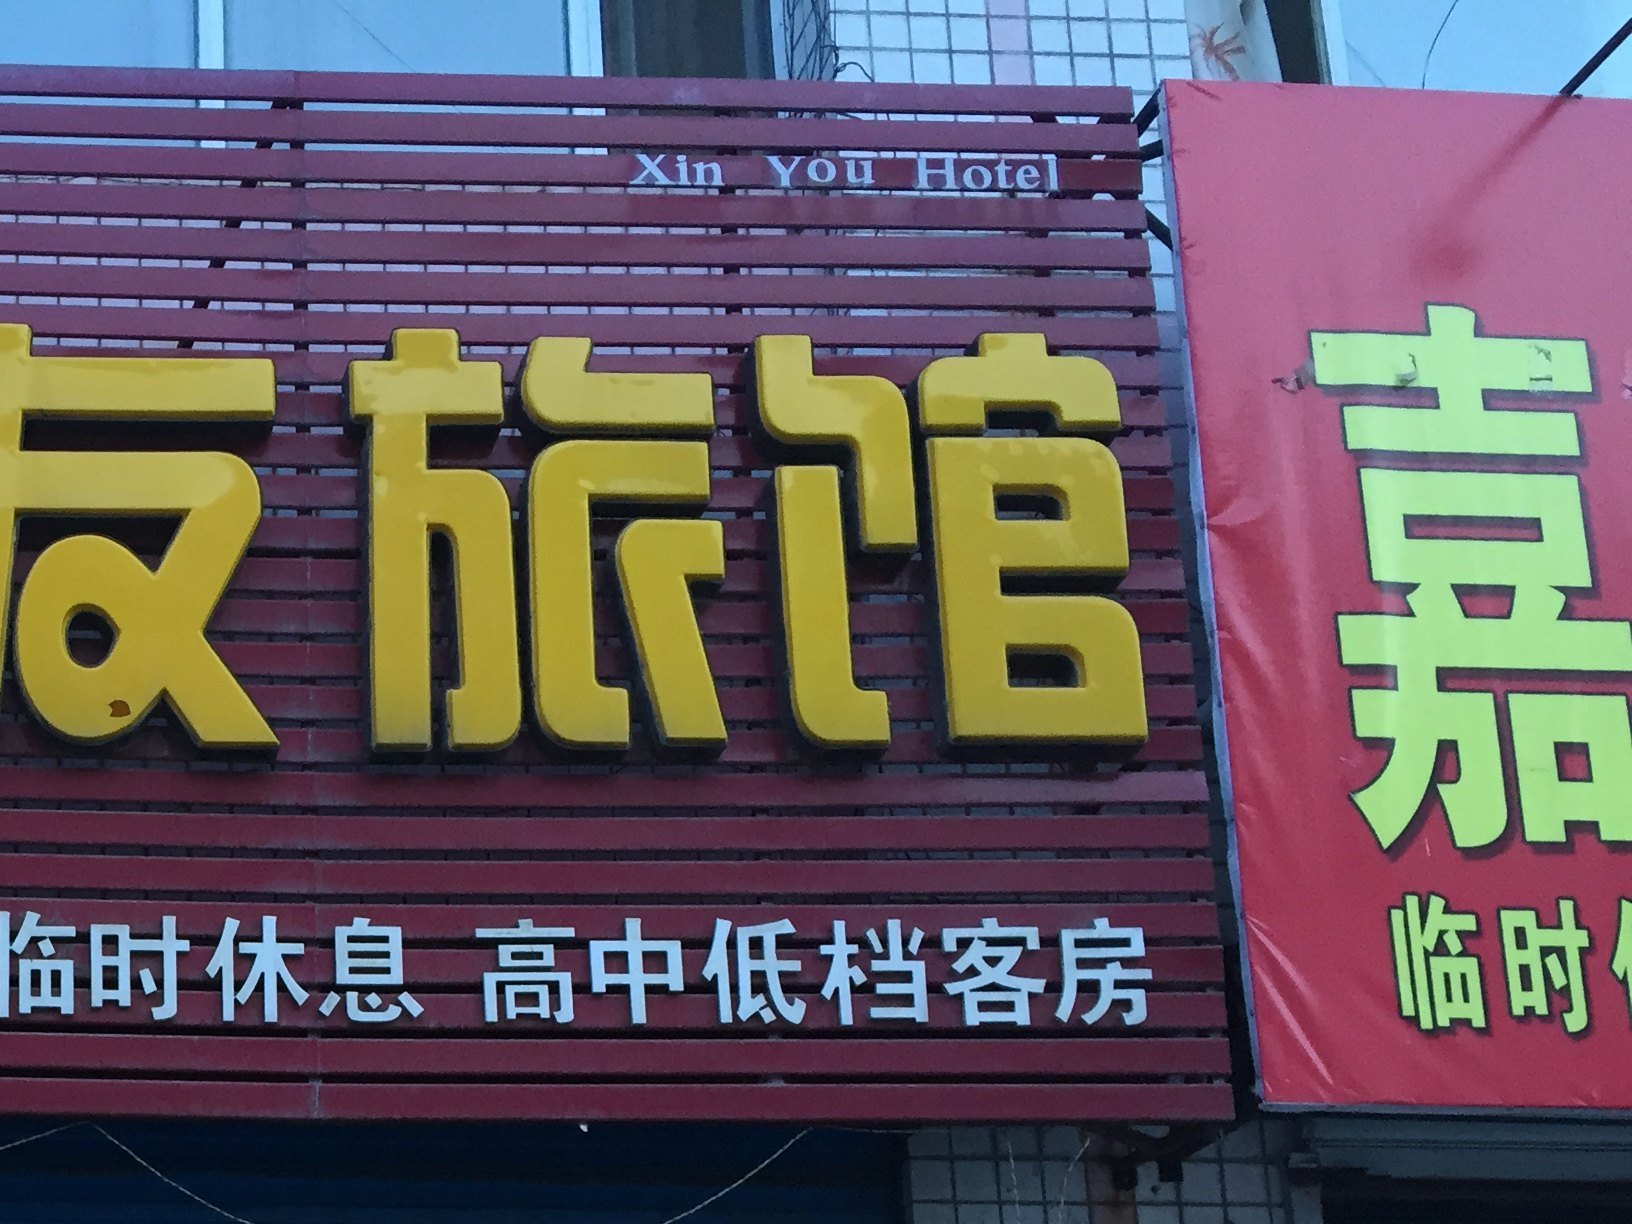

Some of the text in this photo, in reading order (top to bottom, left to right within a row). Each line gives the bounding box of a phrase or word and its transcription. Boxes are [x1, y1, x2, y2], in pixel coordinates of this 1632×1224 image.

[629, 153, 1060, 192] Xin You Hotel
[1309, 303, 1632, 852] 嘉
[475, 917, 1153, 1027] 高中低档客房
